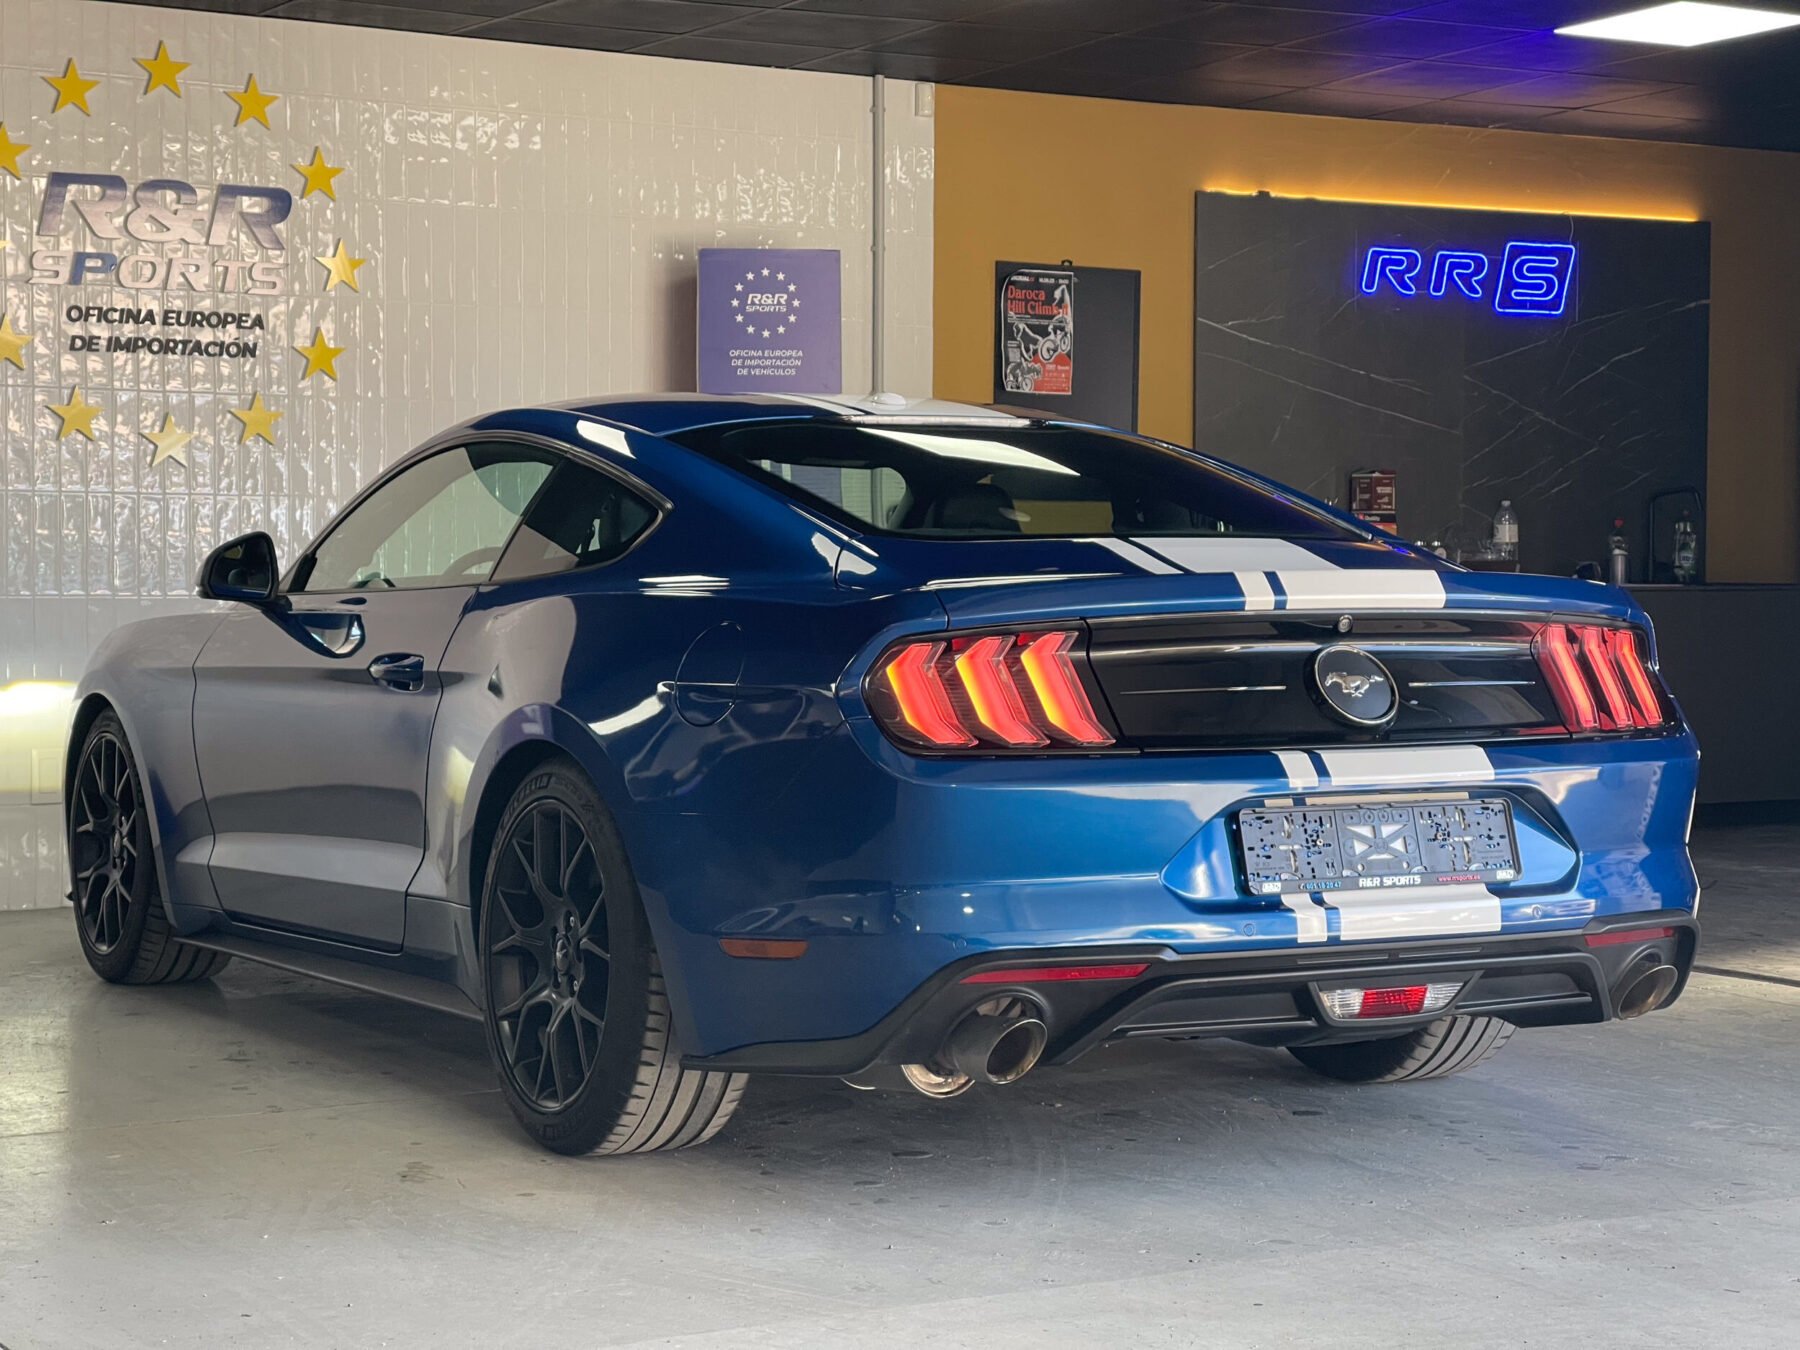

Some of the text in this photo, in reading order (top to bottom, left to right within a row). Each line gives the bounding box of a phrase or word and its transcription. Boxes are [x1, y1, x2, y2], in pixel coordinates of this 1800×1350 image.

[37, 171, 293, 250] R&R
[28, 250, 289, 296] SPORTS
[1362, 246, 1564, 302] RRS
[747, 293, 788, 305] R&R
[1007, 285, 1046, 300] Daroca
[745, 305, 787, 313] SPORTS
[1007, 299, 1025, 314] Hill
[66, 305, 265, 330] OFICINA EUROPEA
[69, 335, 258, 358] DE IMPORTACIÓN
[729, 349, 763, 357] OFICINA
[744, 358, 802, 367] IMPORTACIÓN
[737, 367, 797, 376] DE VEHÍCULOS
[1358, 874, 1422, 888] R&R SPORTS
